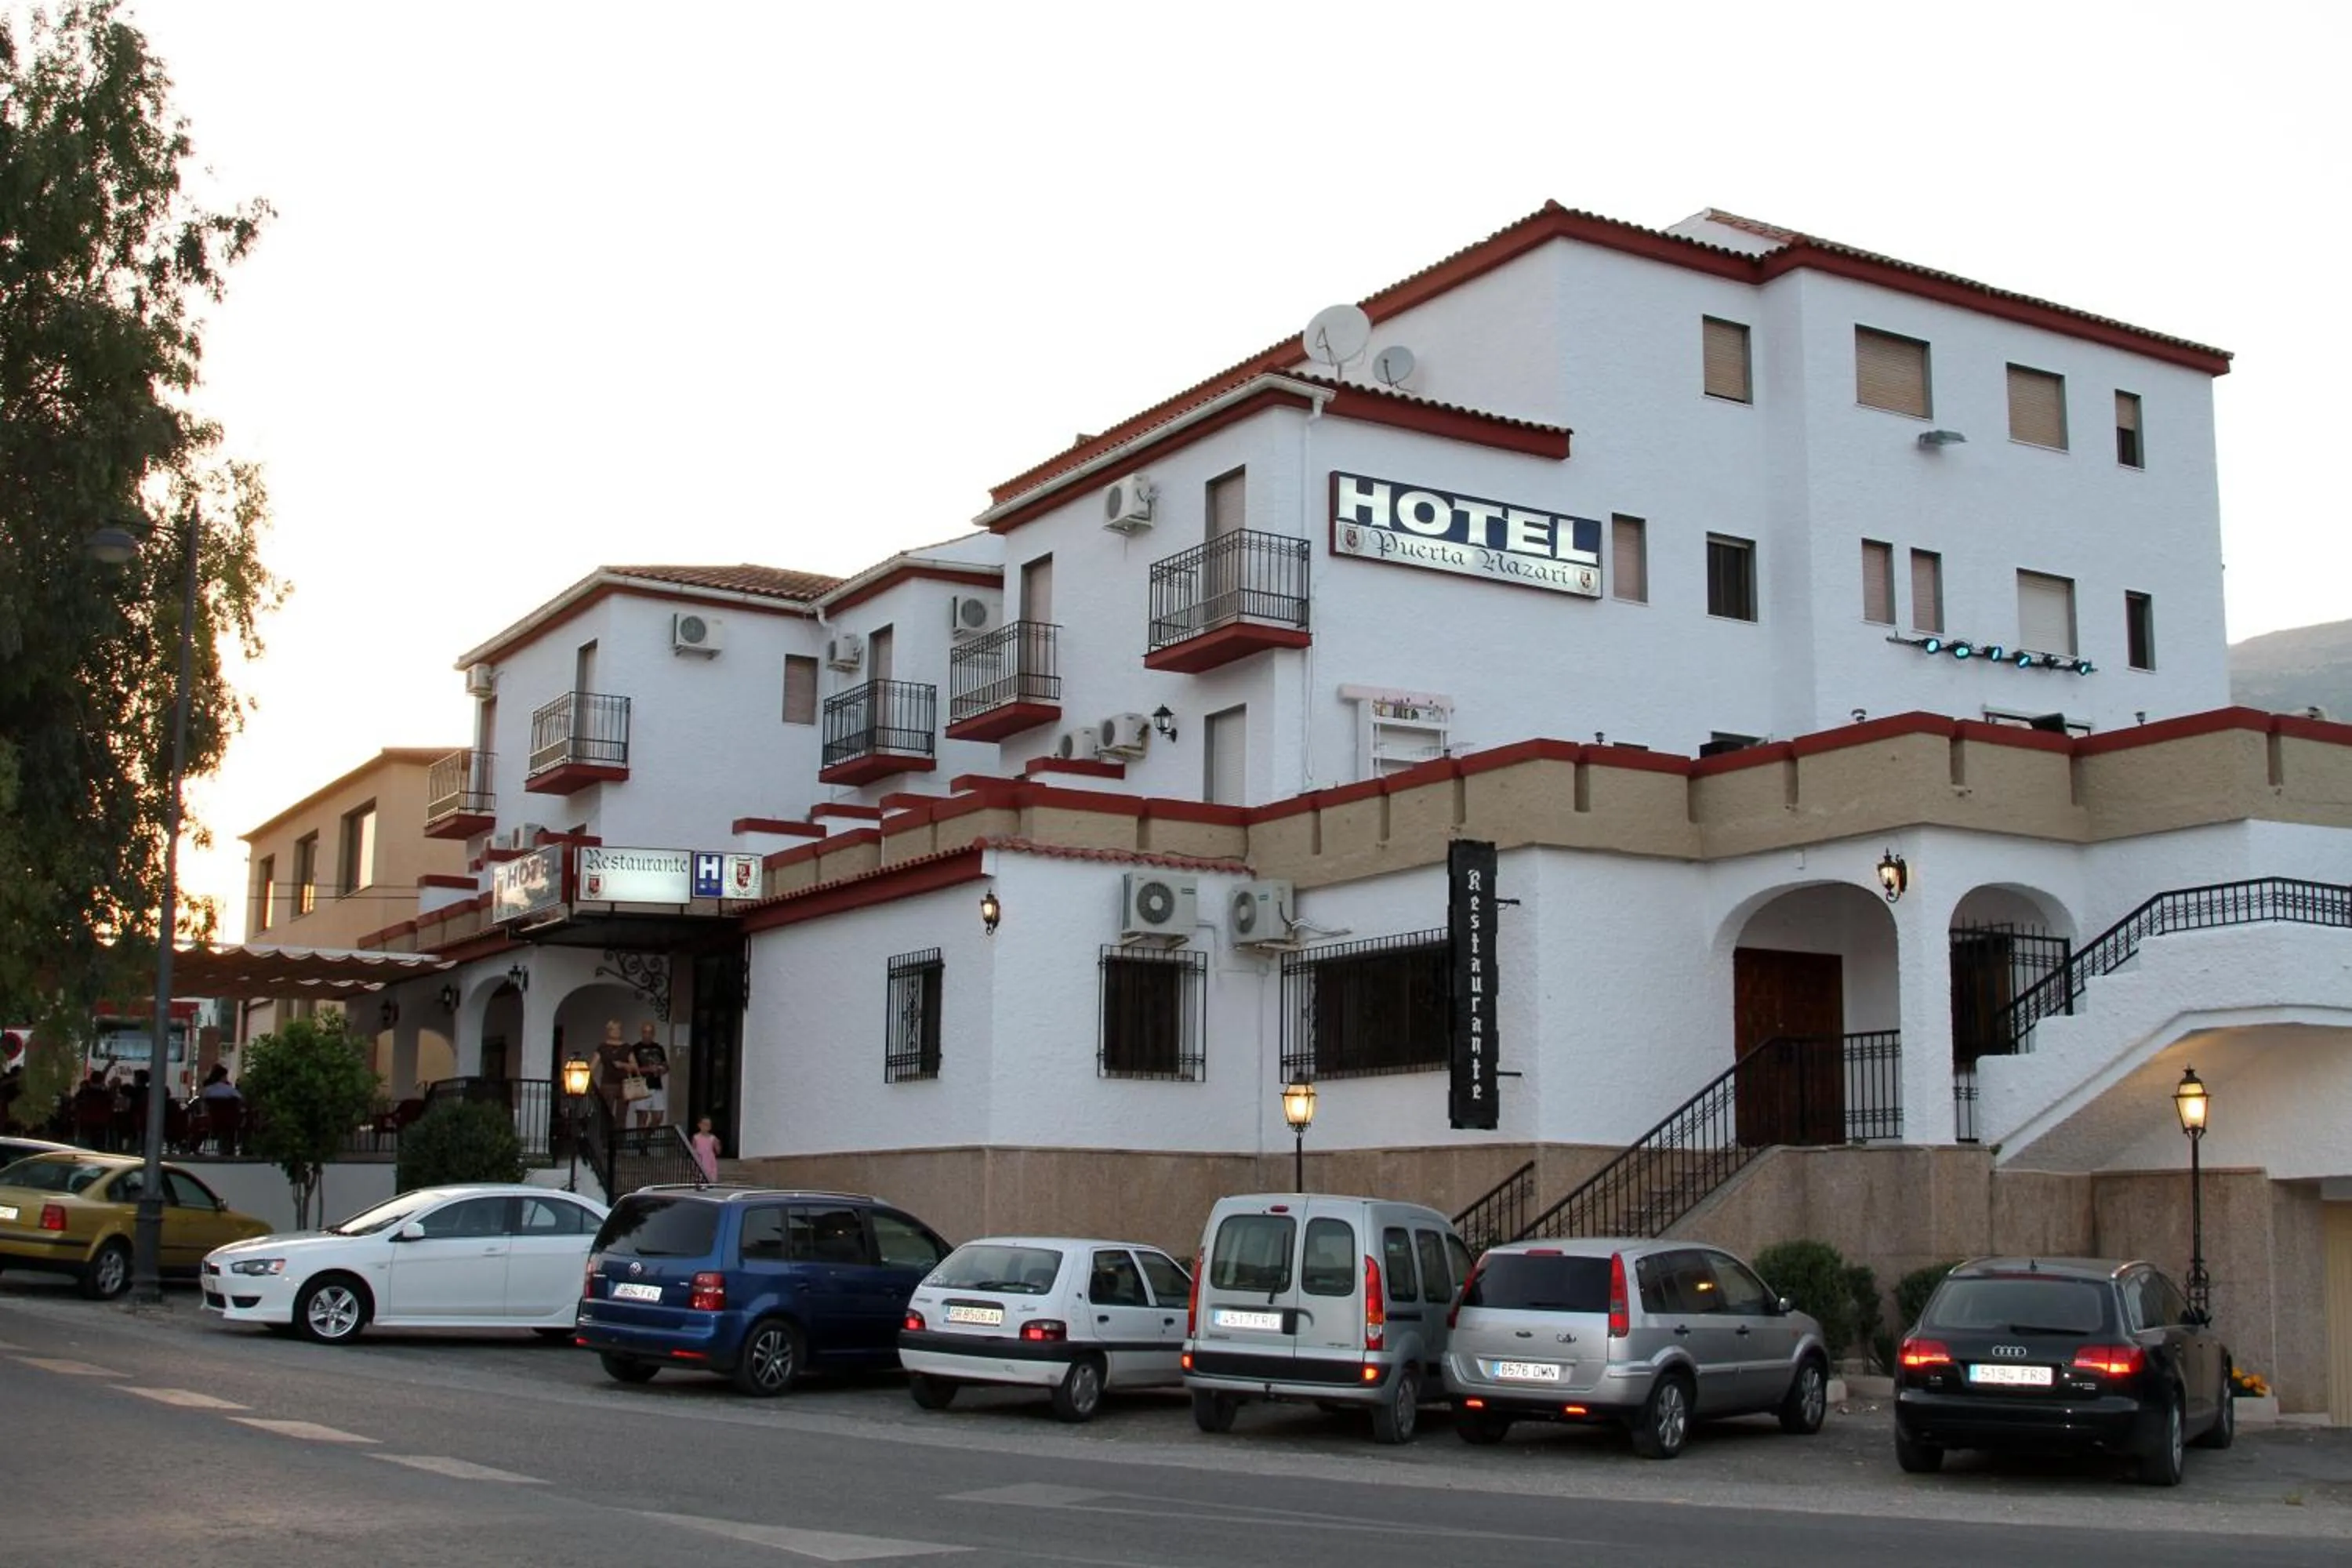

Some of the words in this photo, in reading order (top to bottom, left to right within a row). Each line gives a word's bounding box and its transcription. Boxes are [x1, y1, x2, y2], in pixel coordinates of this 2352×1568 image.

[1338, 476, 1597, 563] HOTEL
[1370, 530, 1465, 565] Puerta
[586, 849, 687, 873] Restaurante
[699, 856, 719, 879] H
[1468, 869, 1482, 1099] Restaurante
